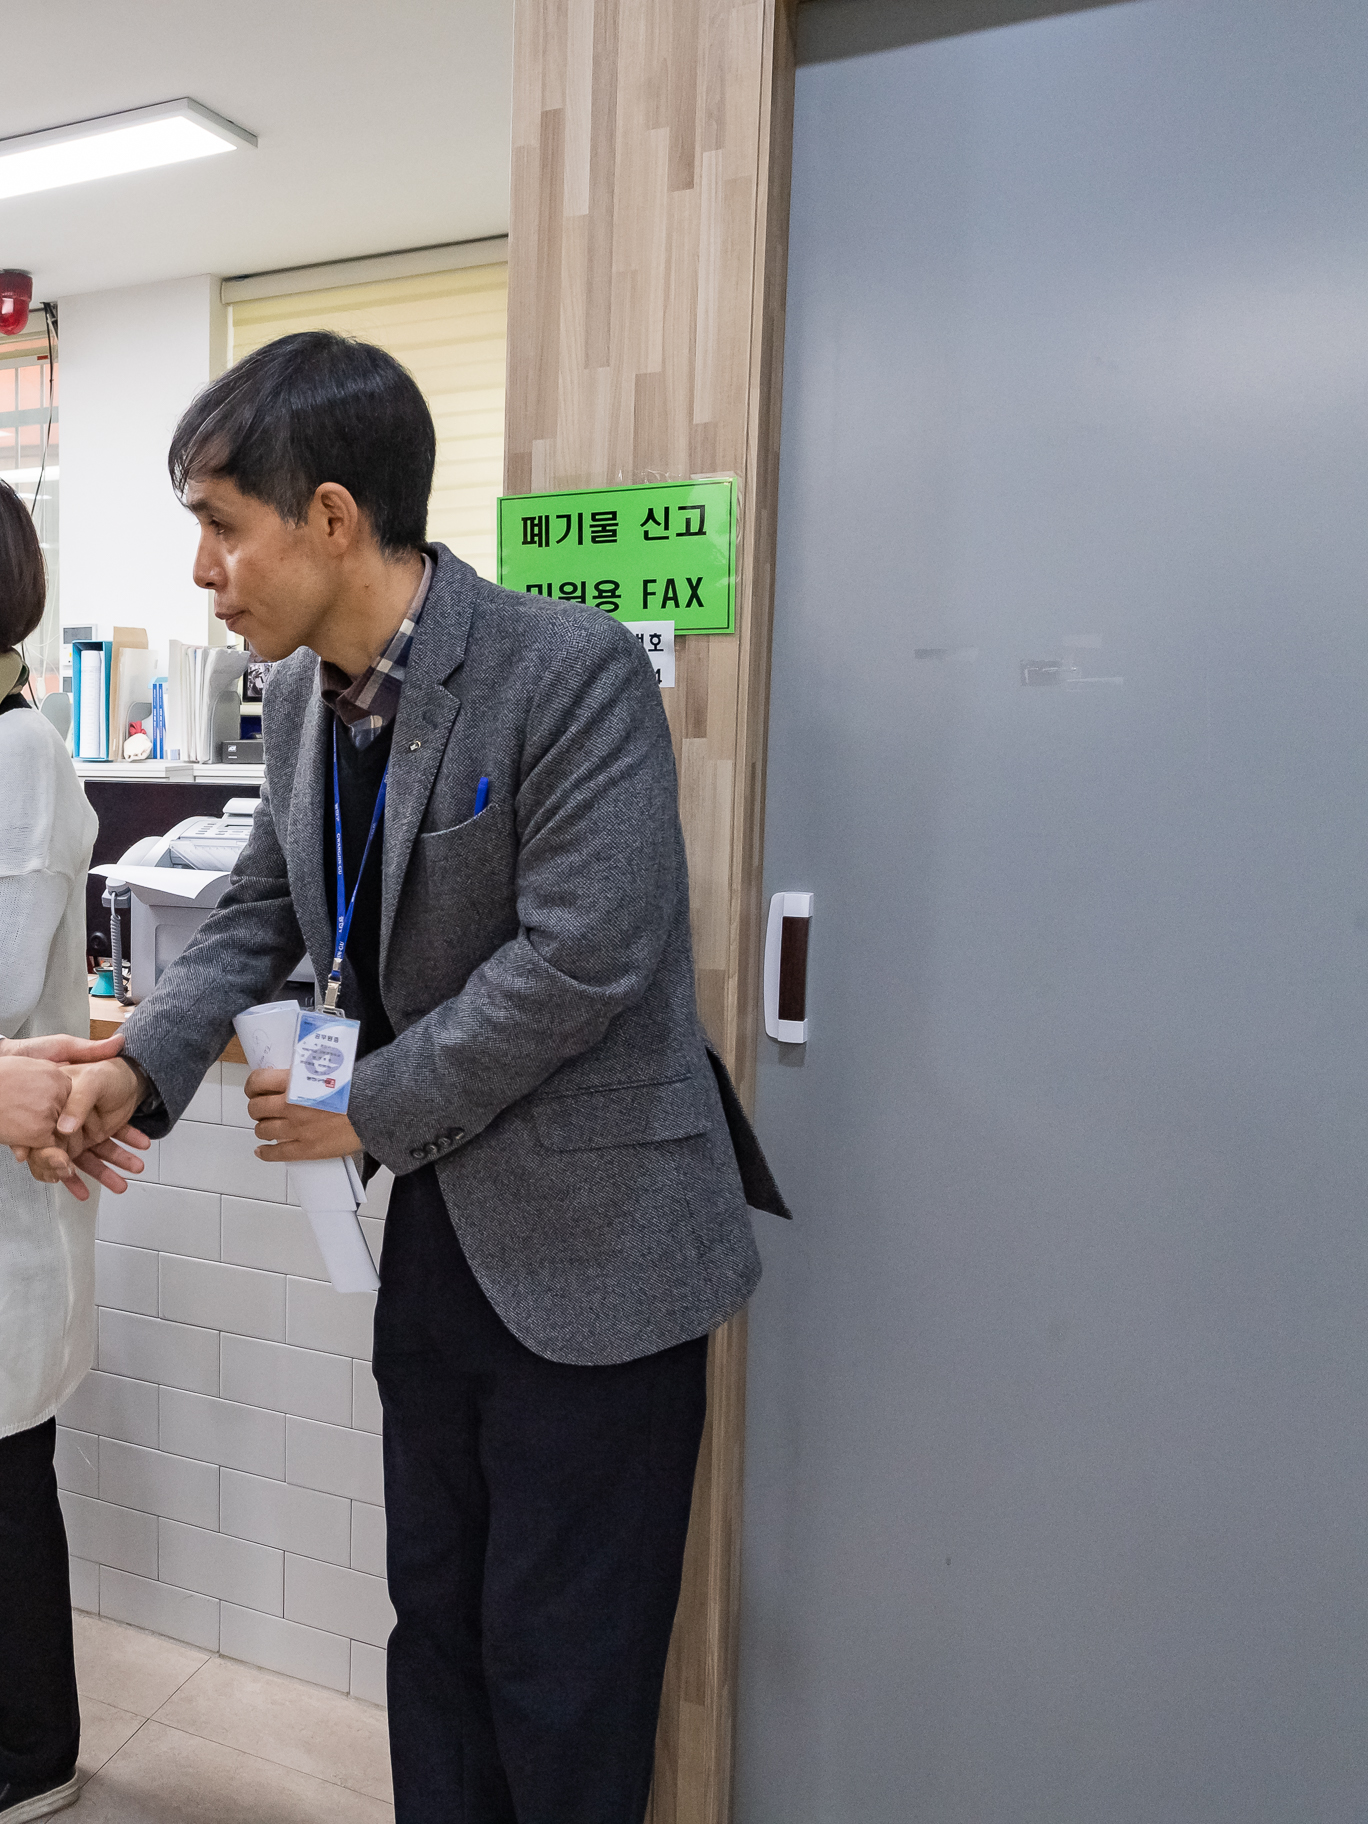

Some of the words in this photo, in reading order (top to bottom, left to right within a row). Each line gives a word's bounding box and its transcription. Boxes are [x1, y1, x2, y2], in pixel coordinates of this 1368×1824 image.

[521, 510, 619, 548] 폐기물
[640, 504, 707, 541] 신고
[642, 577, 705, 609] FAX
